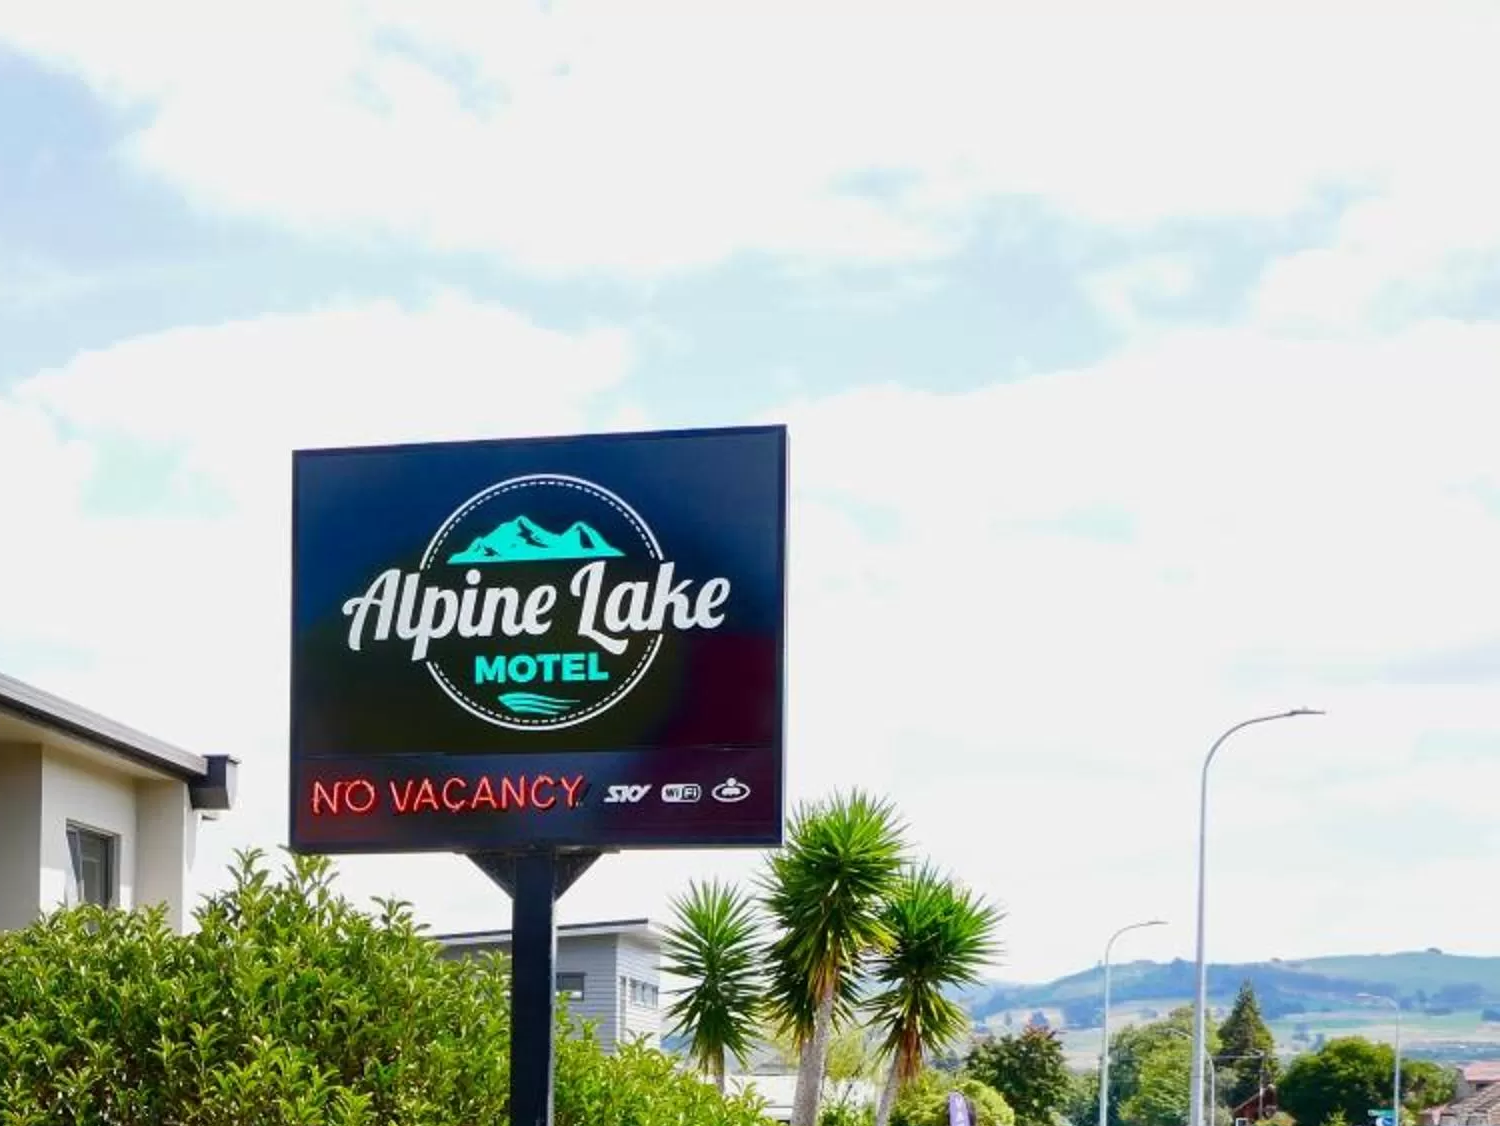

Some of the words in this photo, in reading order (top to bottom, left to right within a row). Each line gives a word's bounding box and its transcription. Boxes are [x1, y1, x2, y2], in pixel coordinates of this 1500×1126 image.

[342, 568, 557, 660] Alpine
[570, 561, 731, 656] Lake
[474, 652, 610, 684] MOTEL
[312, 779, 376, 815] NO
[389, 775, 585, 813] VACANCY
